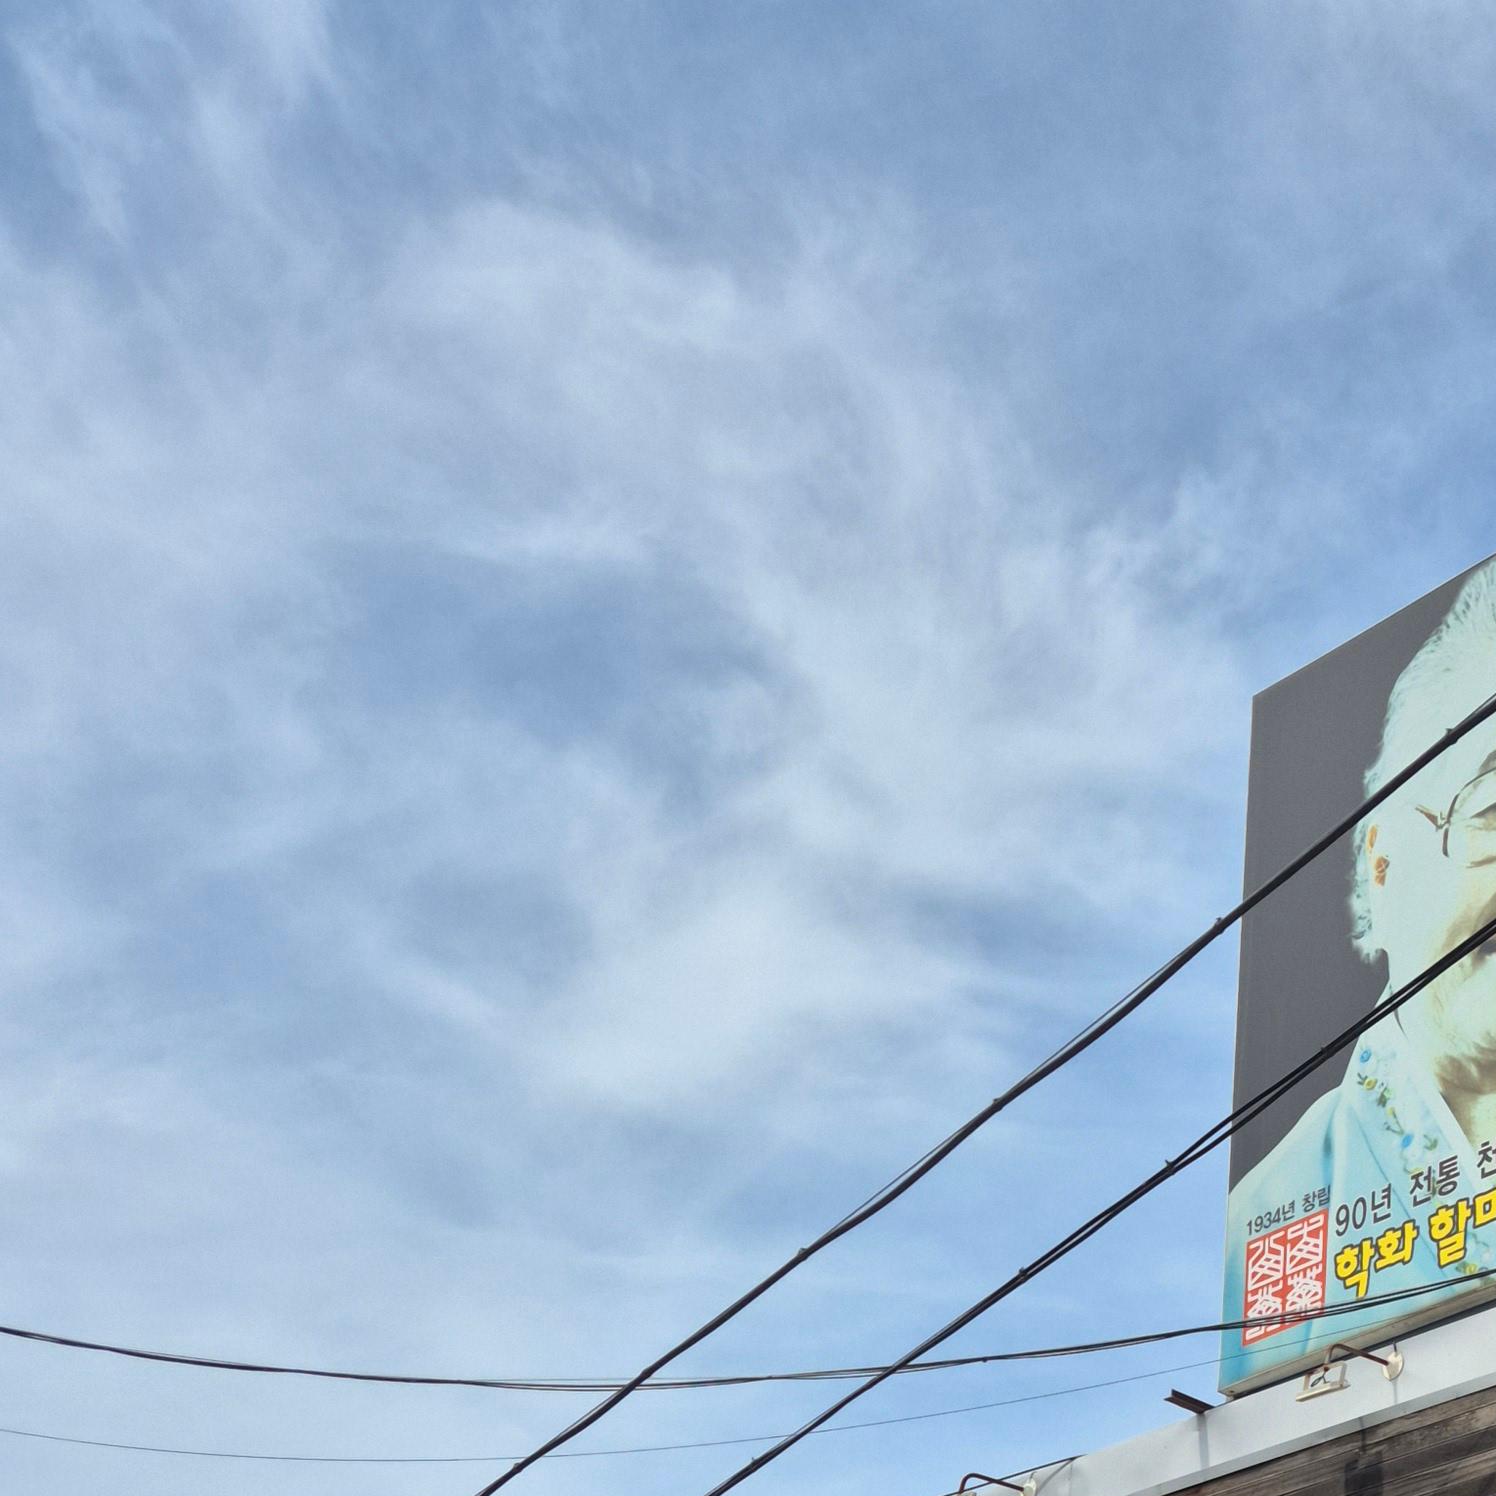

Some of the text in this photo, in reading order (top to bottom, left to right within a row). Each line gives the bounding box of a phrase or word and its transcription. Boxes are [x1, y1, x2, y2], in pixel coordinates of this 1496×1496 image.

[1246, 1184, 1331, 1236] 1934년 창립
[1335, 1183, 1392, 1237] 90년
[1410, 1155, 1461, 1208] 전통
[1334, 1218, 1420, 1299] 학화
